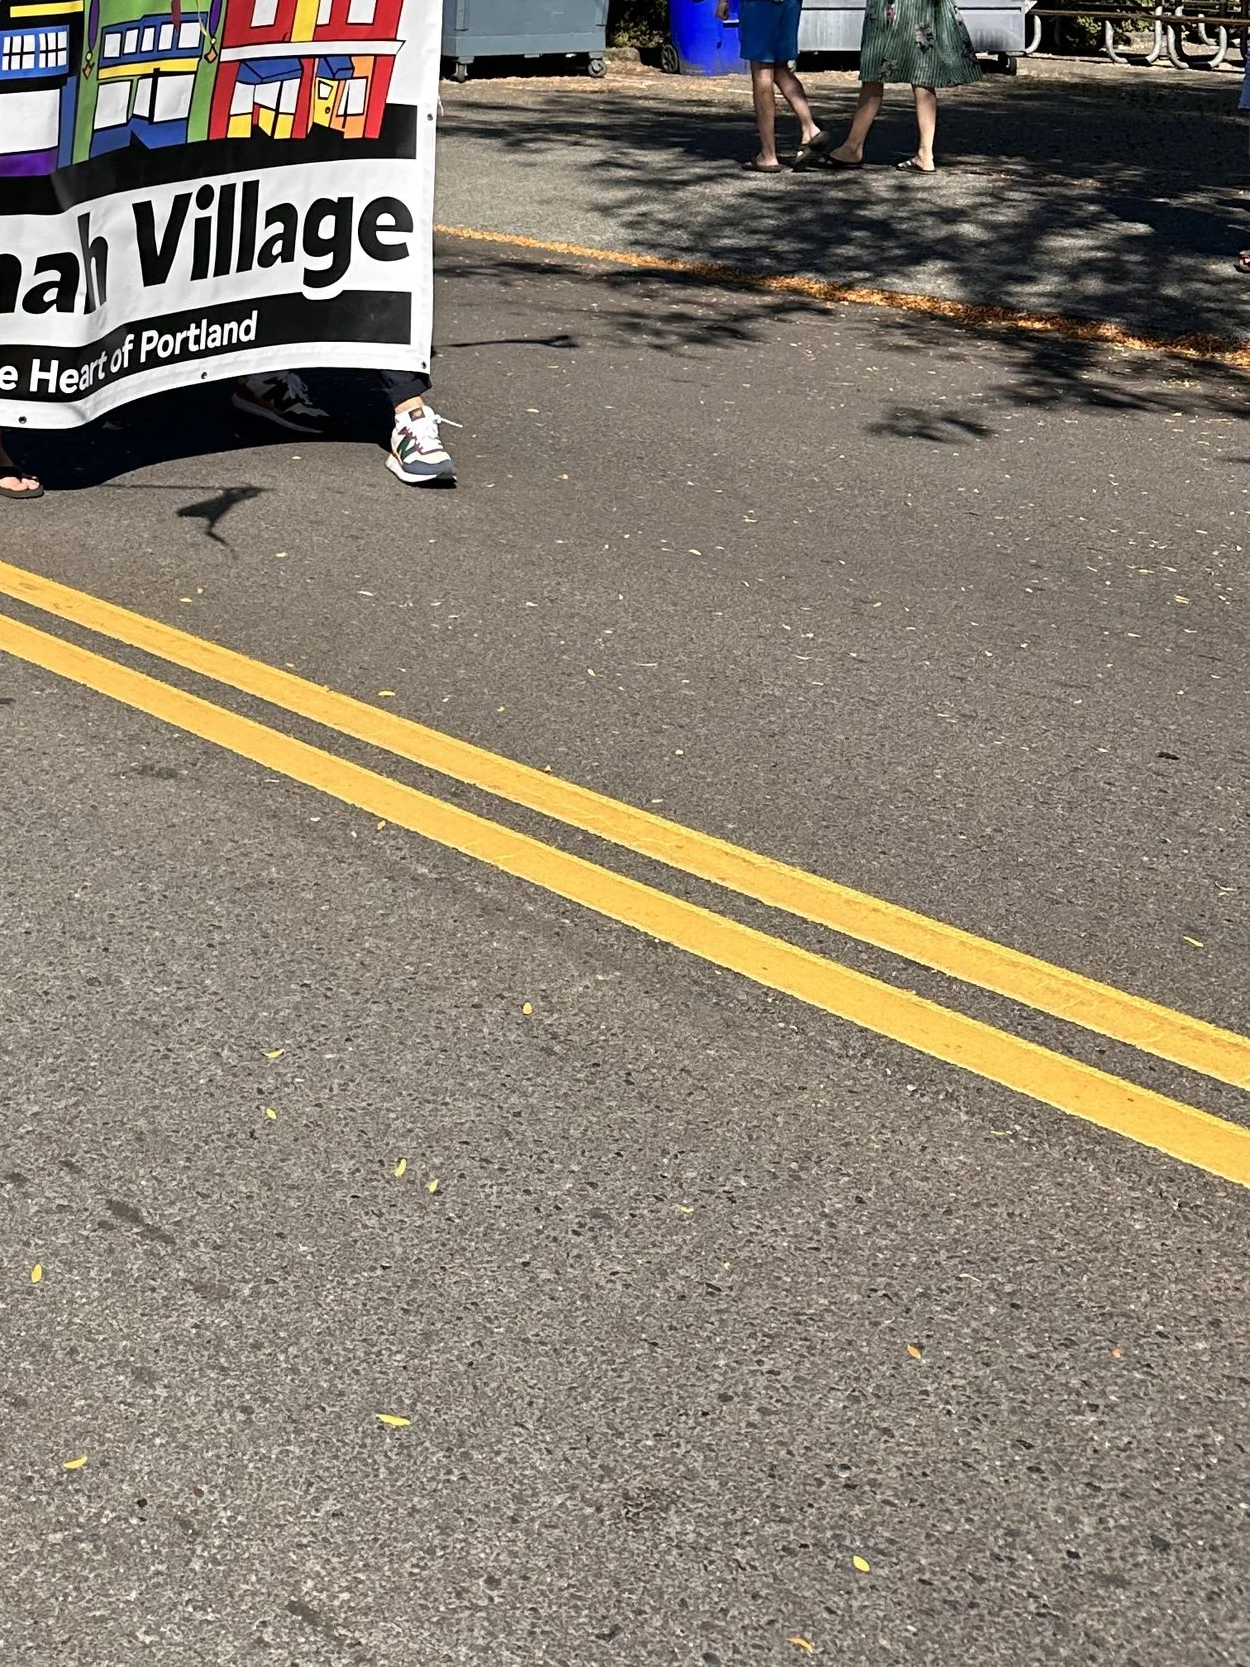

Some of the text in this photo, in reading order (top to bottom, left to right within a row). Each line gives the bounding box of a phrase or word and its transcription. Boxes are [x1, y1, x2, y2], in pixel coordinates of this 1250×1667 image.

[132, 179, 414, 289] Village
[29, 351, 108, 394] Heart
[110, 335, 134, 374] of
[140, 311, 257, 363] Portland
